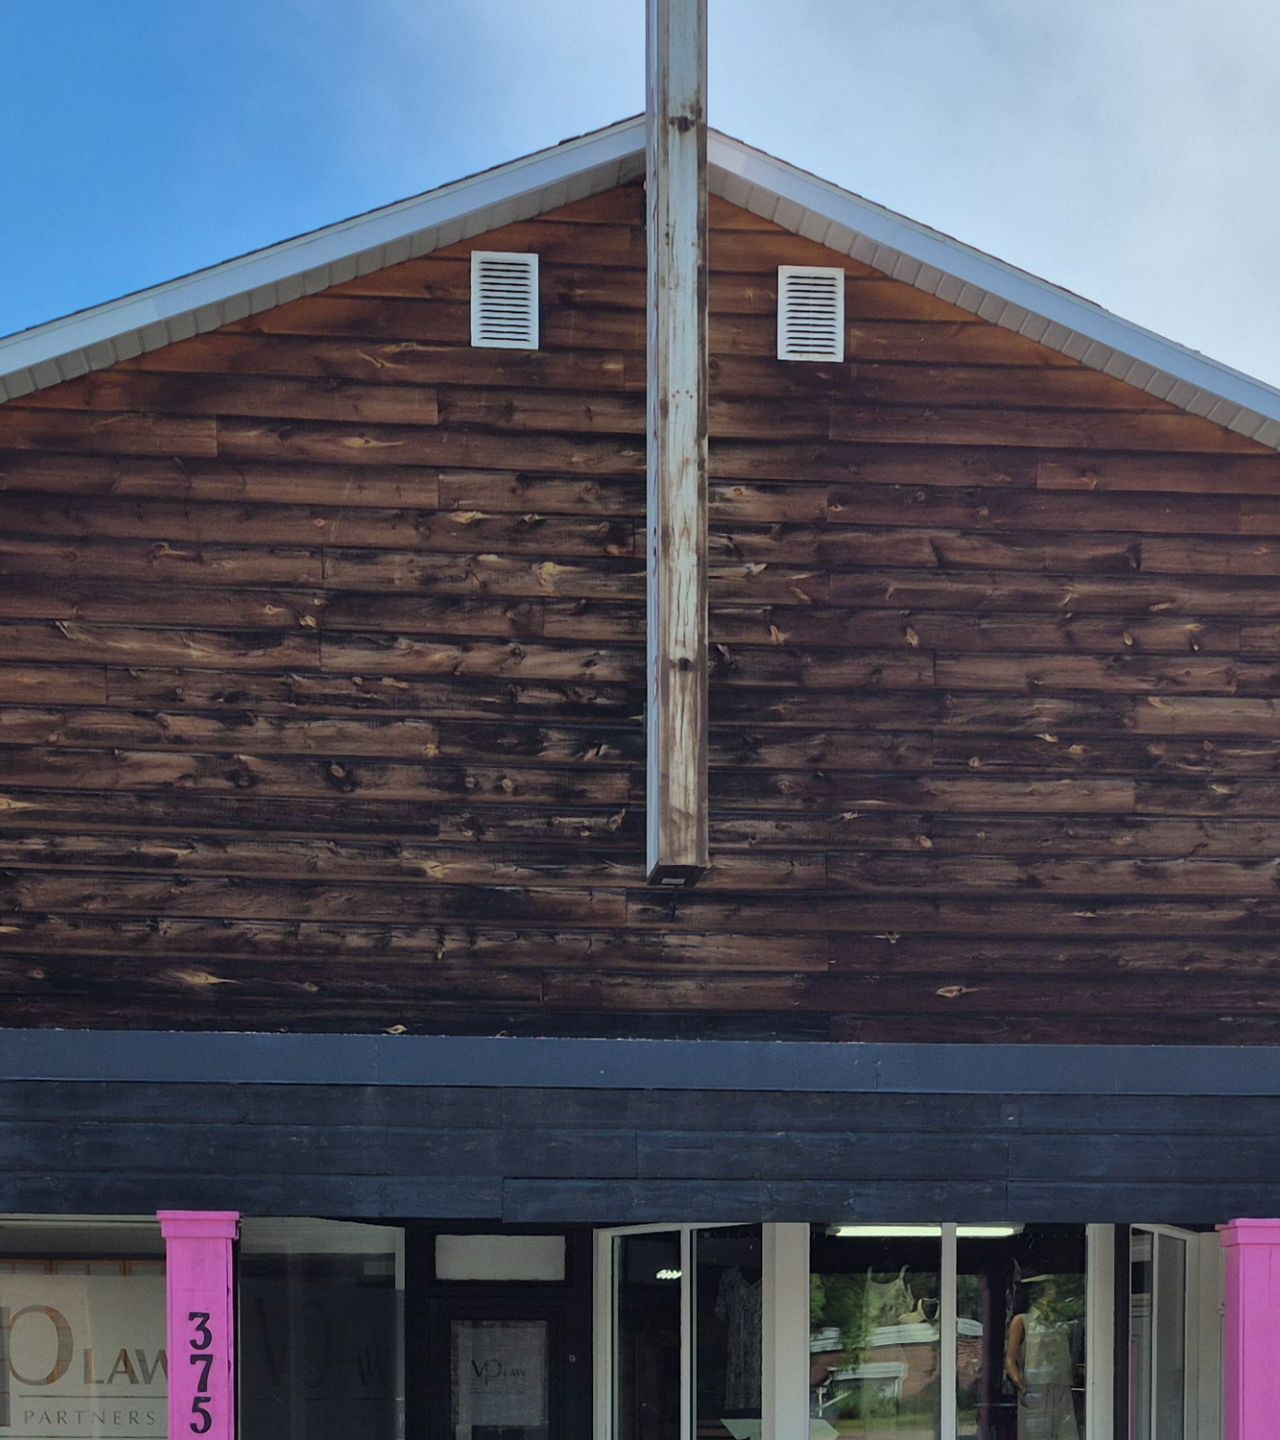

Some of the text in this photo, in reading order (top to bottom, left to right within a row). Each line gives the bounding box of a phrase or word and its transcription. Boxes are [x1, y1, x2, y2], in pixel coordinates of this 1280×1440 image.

[83, 1348, 168, 1385] LAW
[188, 1311, 214, 1435] 375
[24, 1409, 156, 1426] PARTNERS
